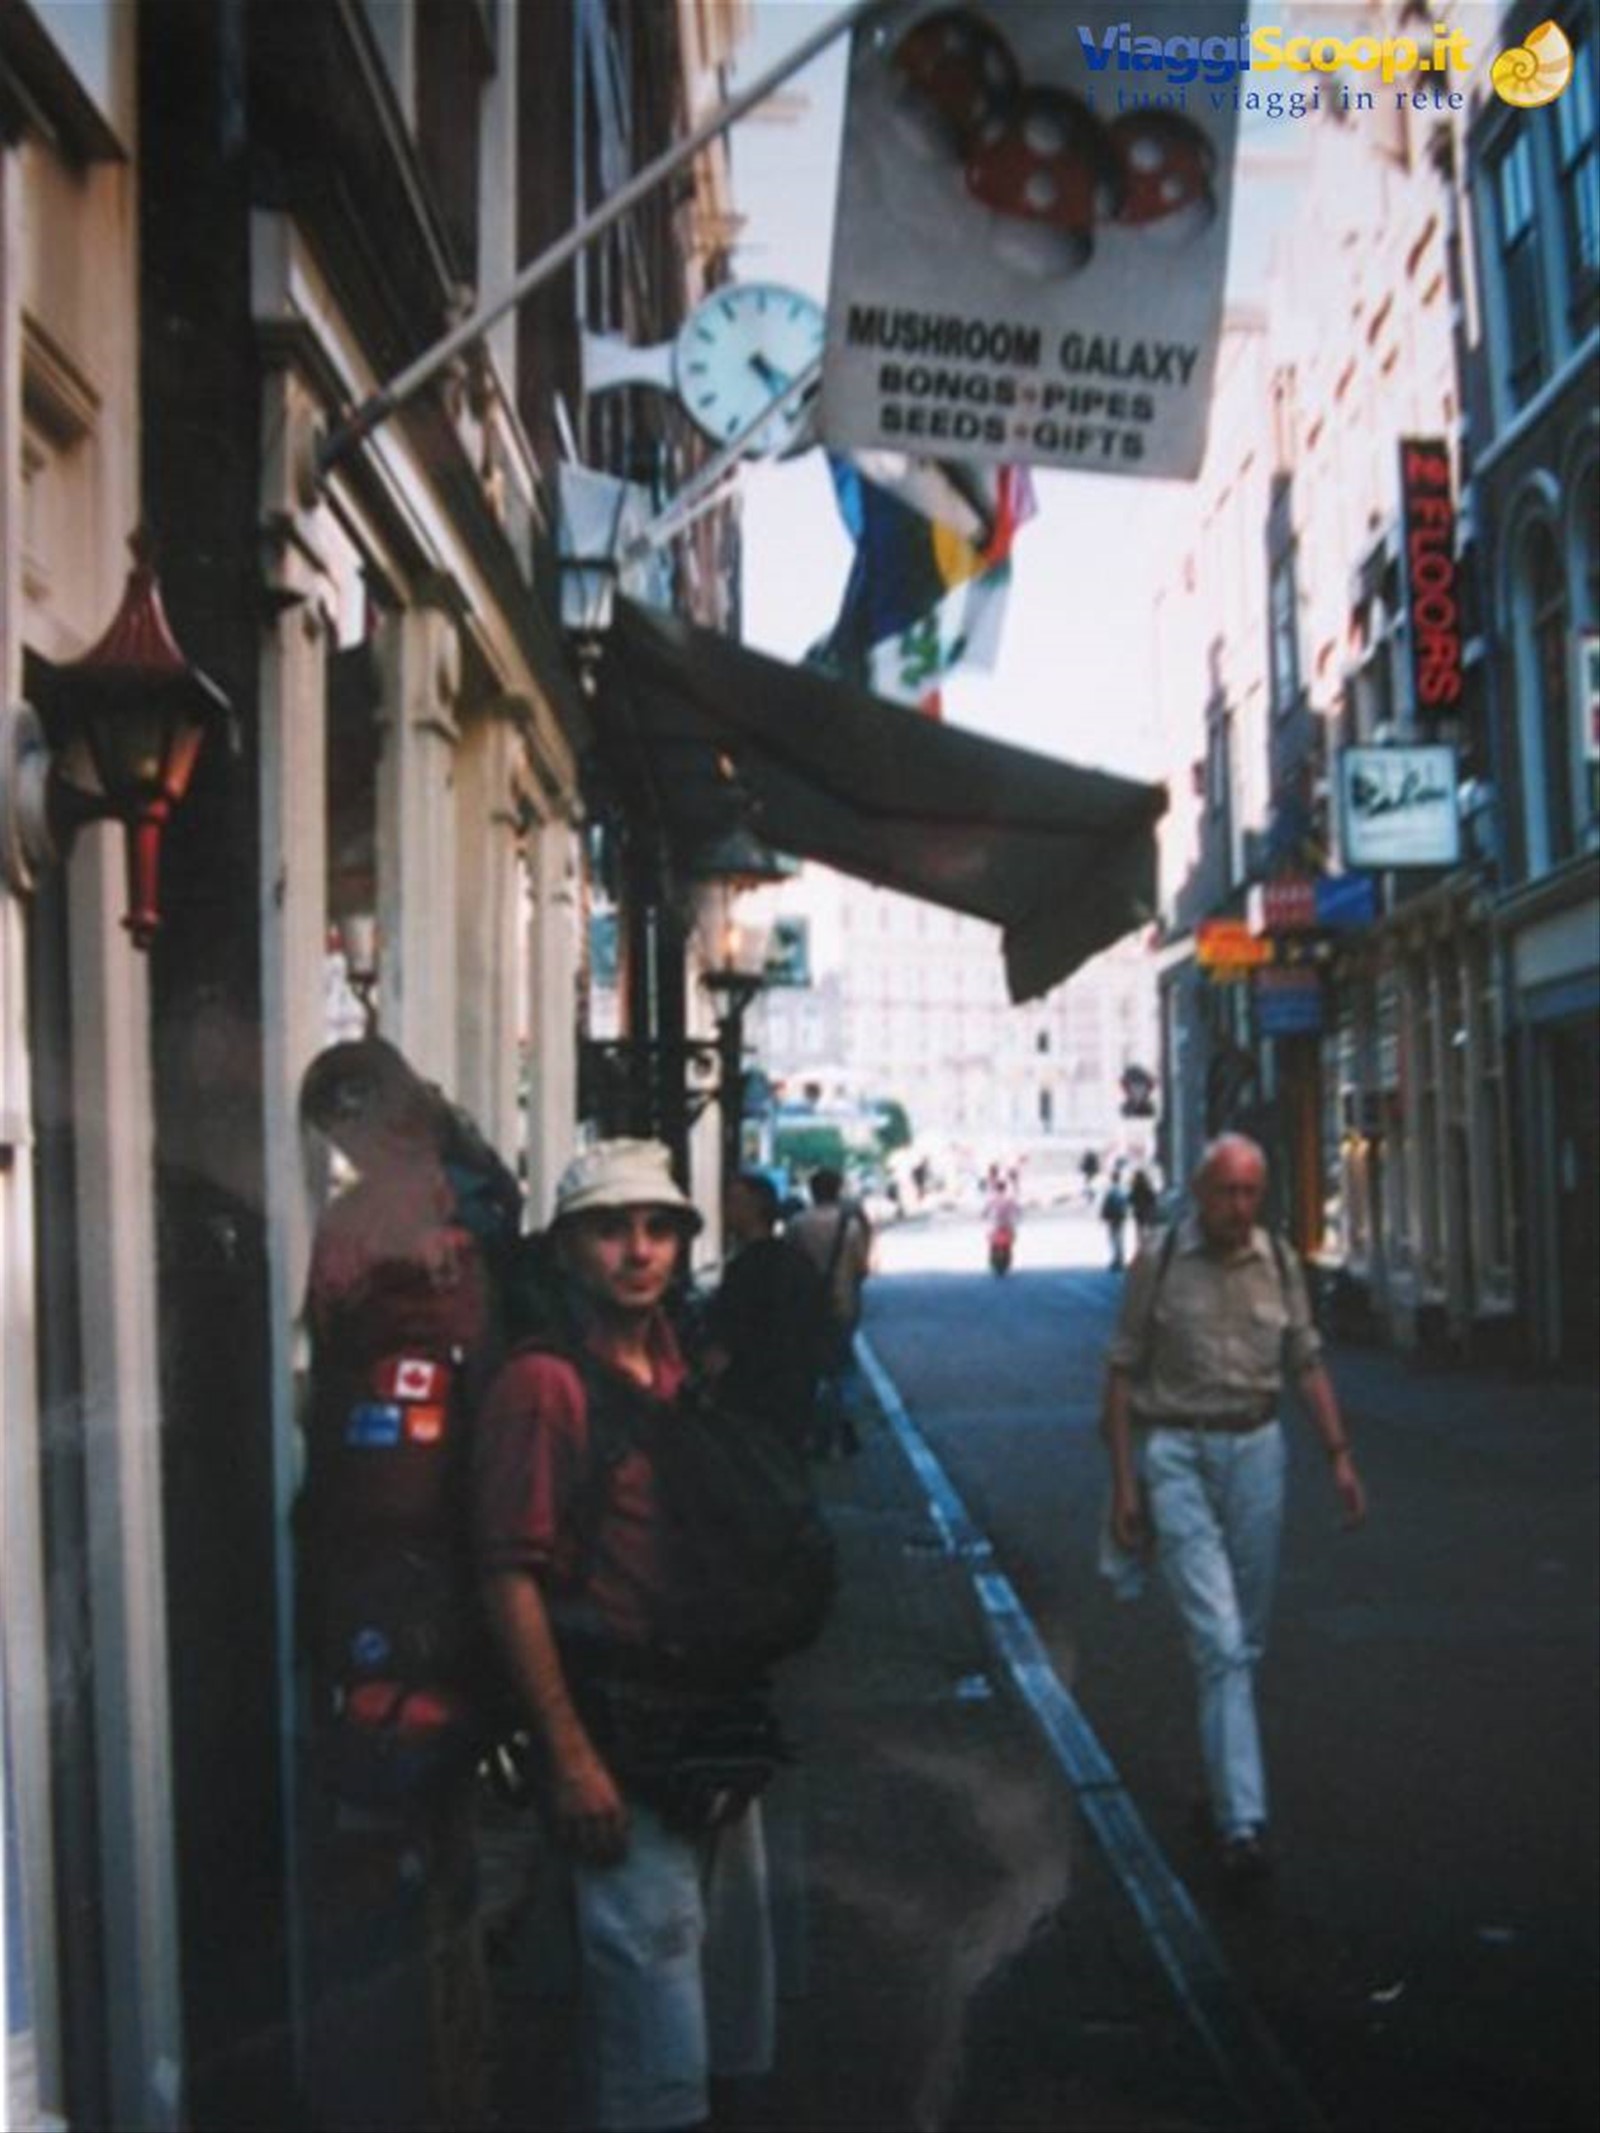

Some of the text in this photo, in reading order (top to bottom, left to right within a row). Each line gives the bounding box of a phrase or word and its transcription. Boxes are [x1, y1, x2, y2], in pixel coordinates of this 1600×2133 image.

[848, 305, 1198, 386] MUSHROOM GALAXY
[880, 363, 1154, 423] BONGS PIPES
[880, 404, 1144, 461] SEEDS GIFTS
[1411, 496, 1462, 704] FLOORS
